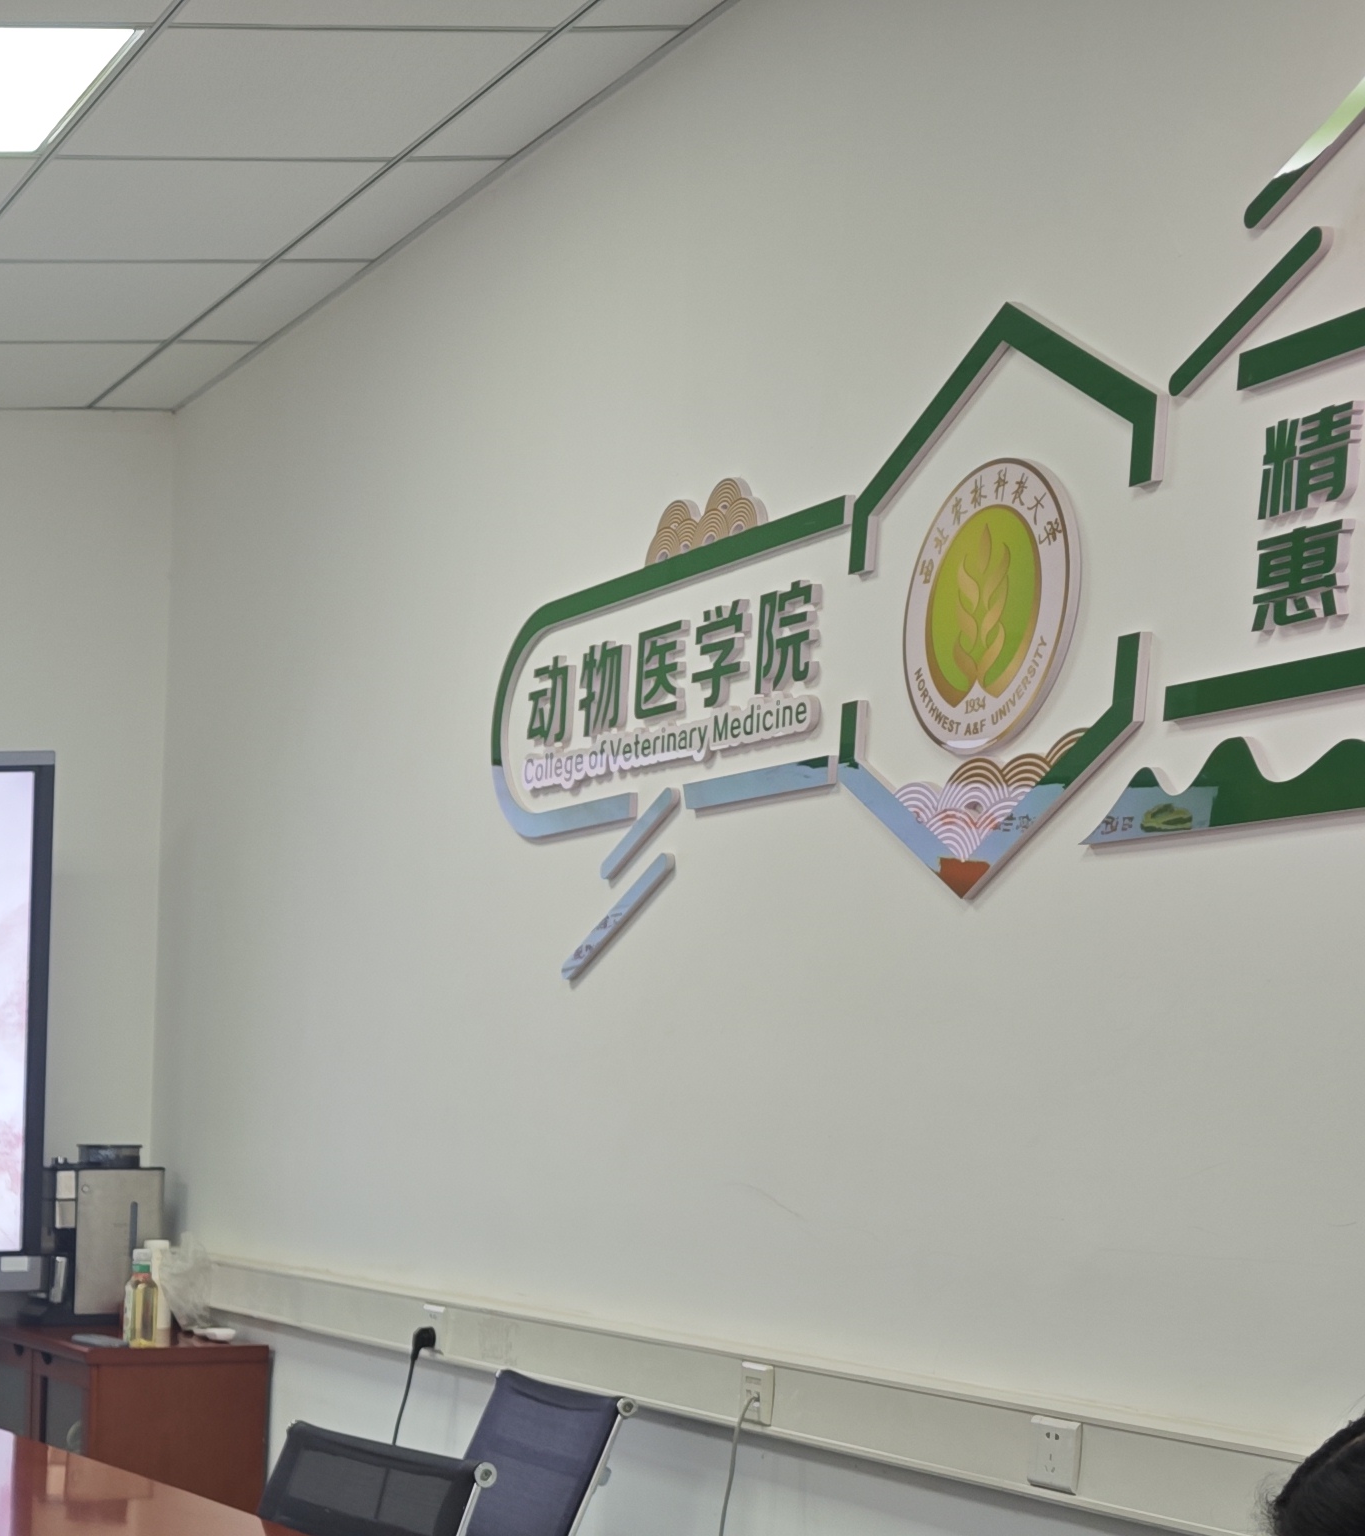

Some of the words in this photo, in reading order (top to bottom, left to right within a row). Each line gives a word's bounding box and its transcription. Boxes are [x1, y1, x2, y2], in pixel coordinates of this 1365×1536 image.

[1257, 400, 1355, 520] 精
[1251, 519, 1345, 632] 惠
[527, 580, 819, 745] 动物医学院
[914, 667, 961, 736] NORTHWEST
[964, 718, 986, 736] A&F
[991, 635, 1048, 726] UNIVERSITY
[964, 696, 986, 714] 1934
[524, 752, 584, 785] College
[588, 743, 609, 769] of
[610, 724, 708, 766] Veterinary
[713, 701, 807, 742] Medicine
